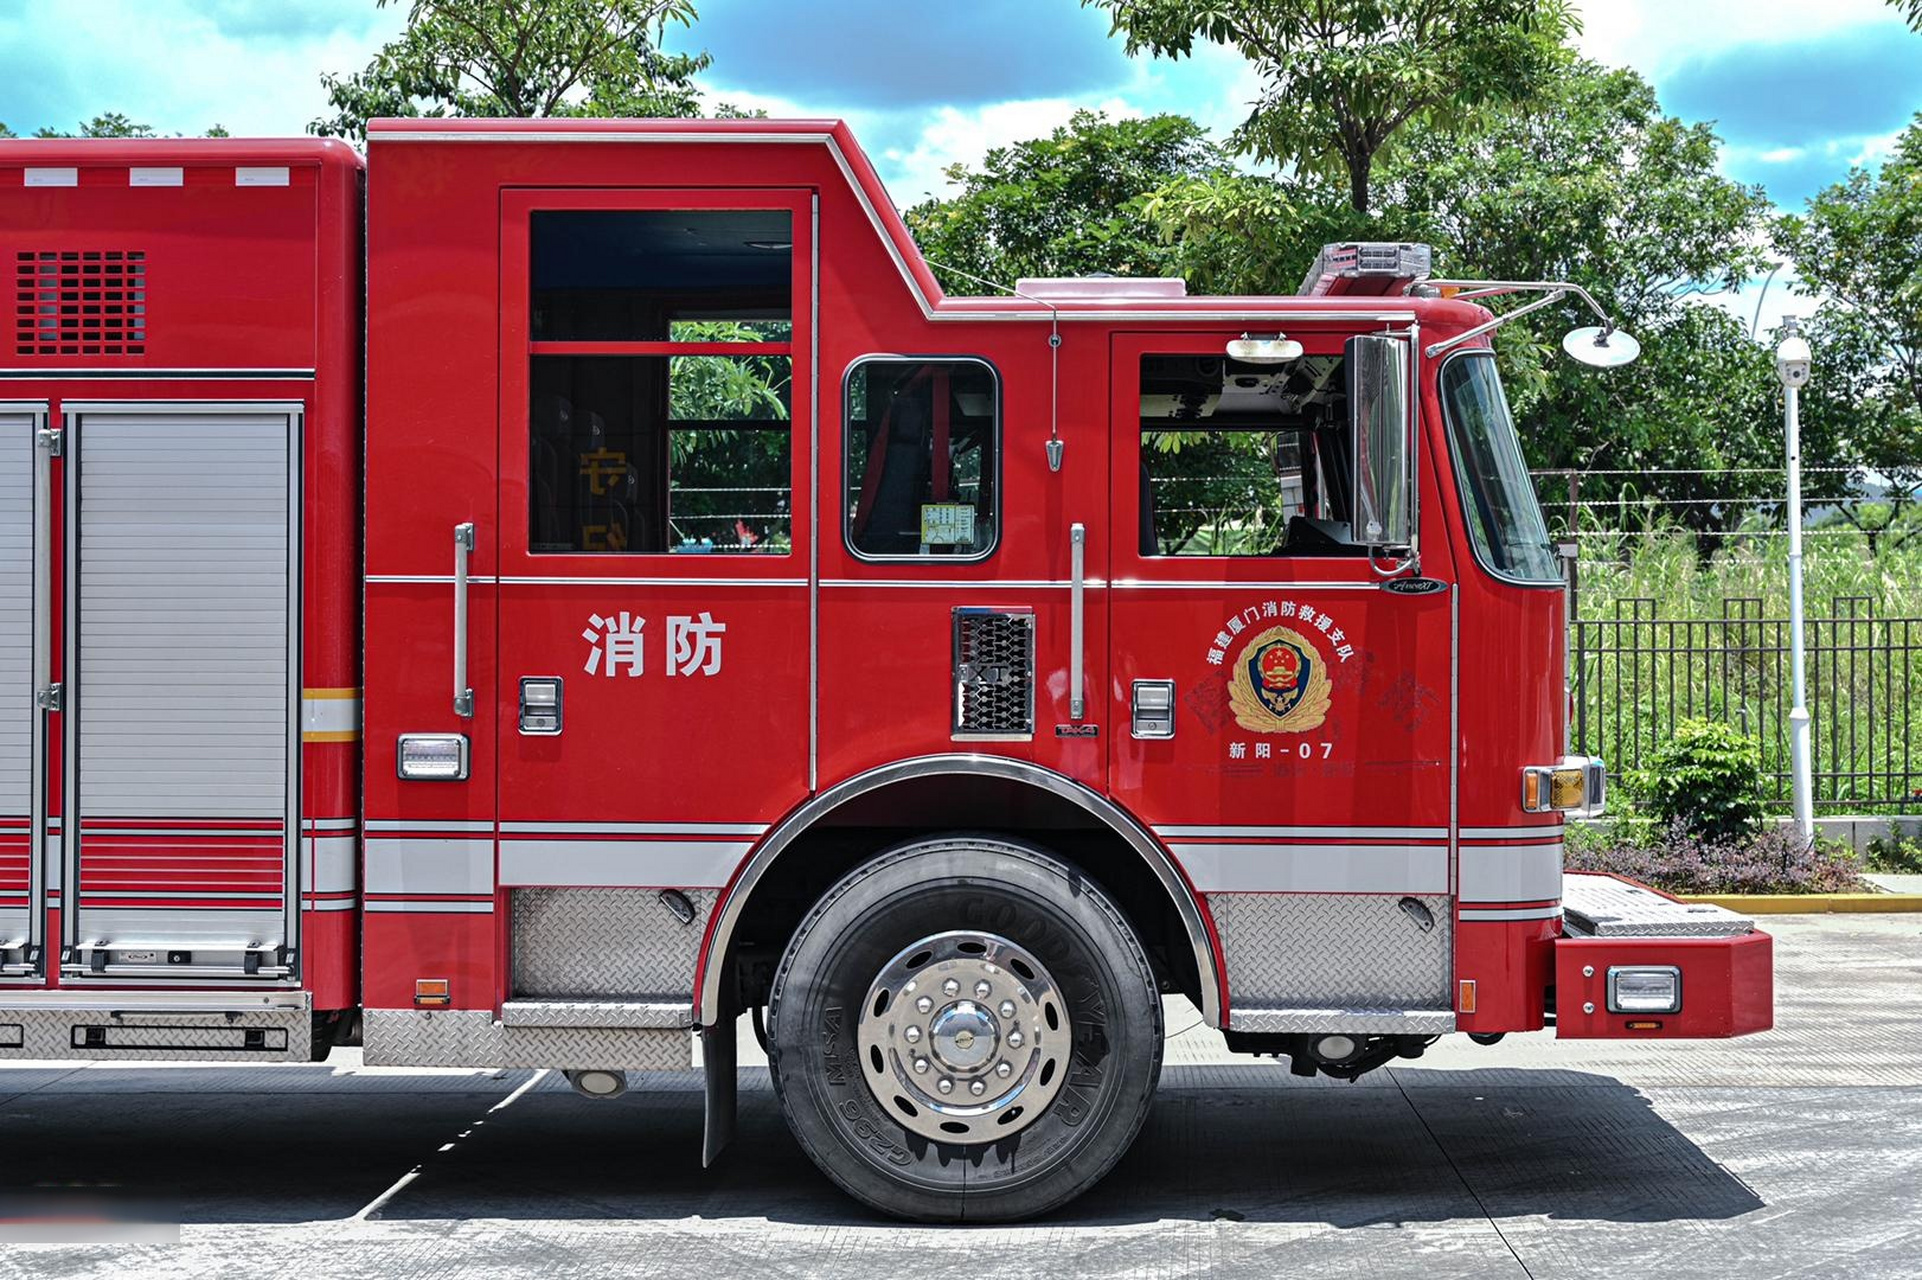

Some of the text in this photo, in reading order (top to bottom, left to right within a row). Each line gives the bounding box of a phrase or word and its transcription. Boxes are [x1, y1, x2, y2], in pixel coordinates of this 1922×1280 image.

[582, 611, 726, 677] 消防
[1206, 601, 1355, 666] 福建厦门消防救援支队
